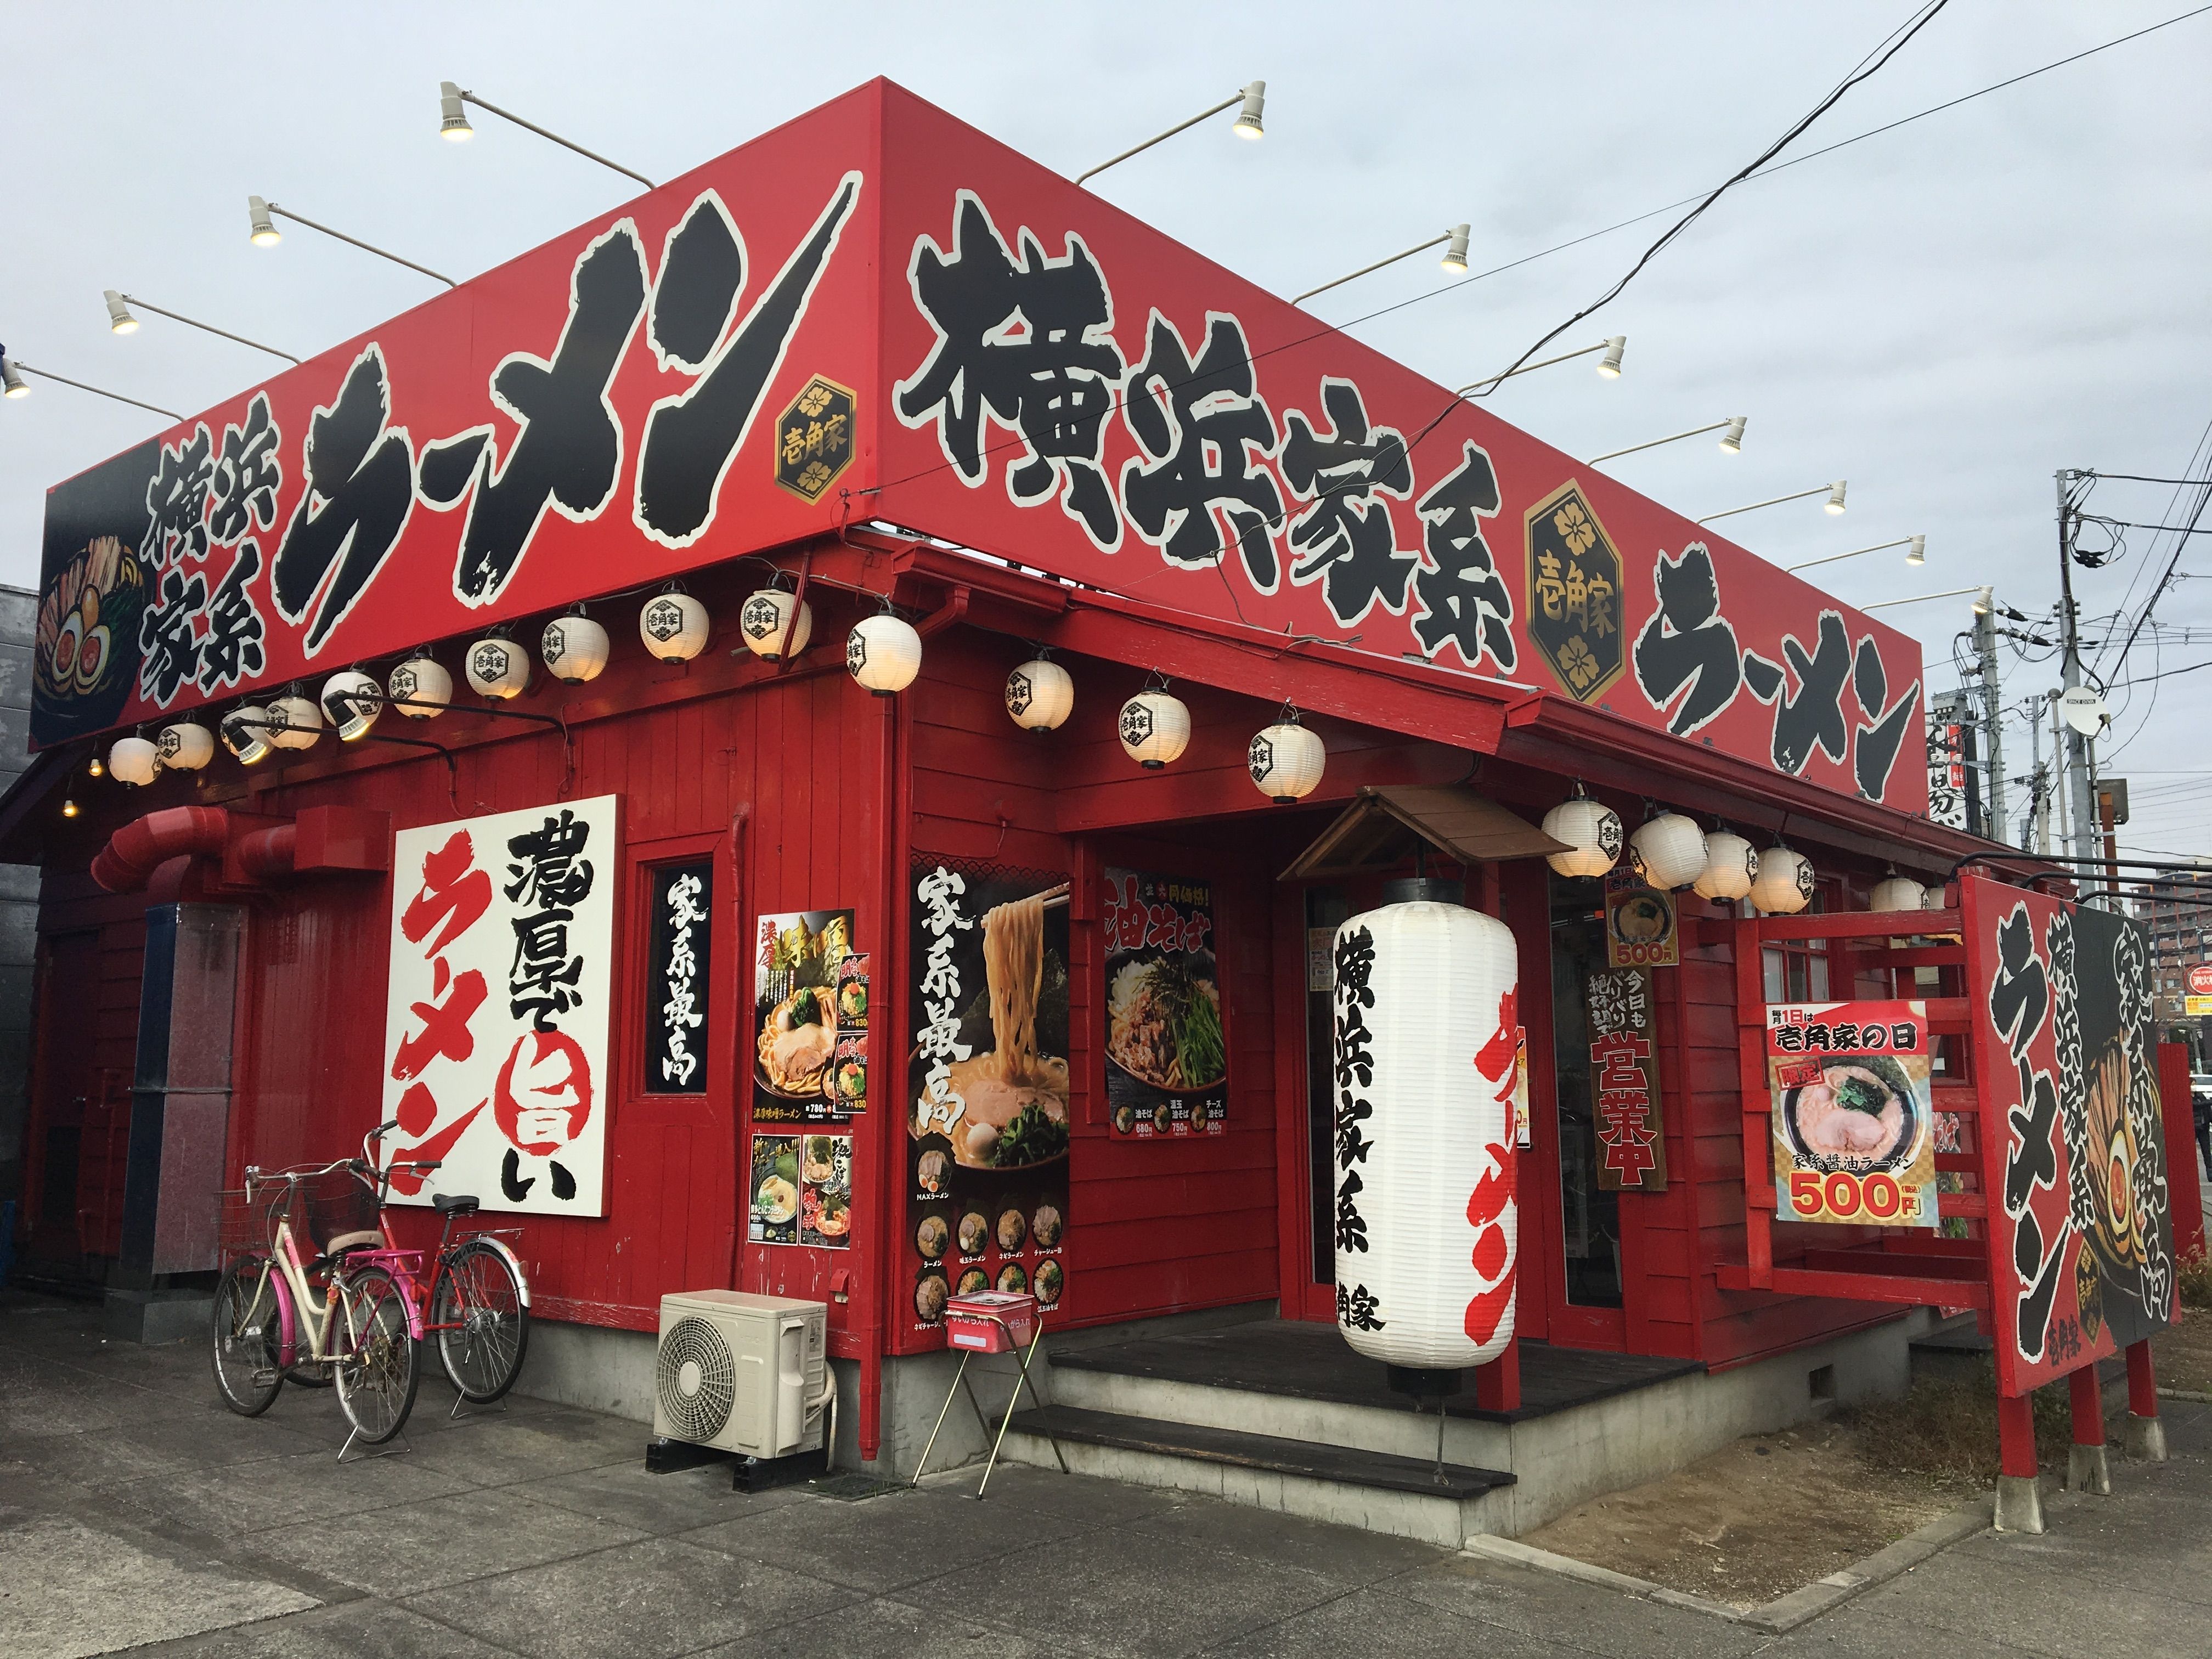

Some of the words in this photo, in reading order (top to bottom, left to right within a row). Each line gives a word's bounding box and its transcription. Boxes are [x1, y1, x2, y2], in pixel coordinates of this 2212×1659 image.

[140, 391, 281, 571] 横浜
[271, 170, 863, 659] ラーメン
[782, 413, 848, 466] 壱角家
[893, 189, 1517, 675] 横浜家系
[139, 537, 266, 709] 家系
[476, 654, 506, 668] 壱角家
[649, 612, 679, 626] 壱角家
[1536, 549, 1617, 639] 壱角家
[1634, 541, 1921, 804] ラーメン
[388, 828, 493, 1196] ラーメン
[662, 873, 710, 1086] 家系最高
[917, 866, 977, 1135] 家系最高
[1775, 1022, 1917, 1053] 壱角家の日
[1334, 925, 1375, 1254] 横浜家系
[1590, 1030, 1657, 1186] 営業中
[1781, 1063, 1820, 1086] 限定
[1791, 1153, 1916, 1171] 家系醤油ラーメン
[1990, 899, 2072, 1365] ラーメン
[2046, 911, 2095, 1234] 横浜家系
[2113, 920, 2170, 1323] 家系最高
[917, 1192, 949, 1201] MAXラーメン
[1464, 982, 1518, 1347] ラーメン
[923, 1260, 942, 1268] ラーメン
